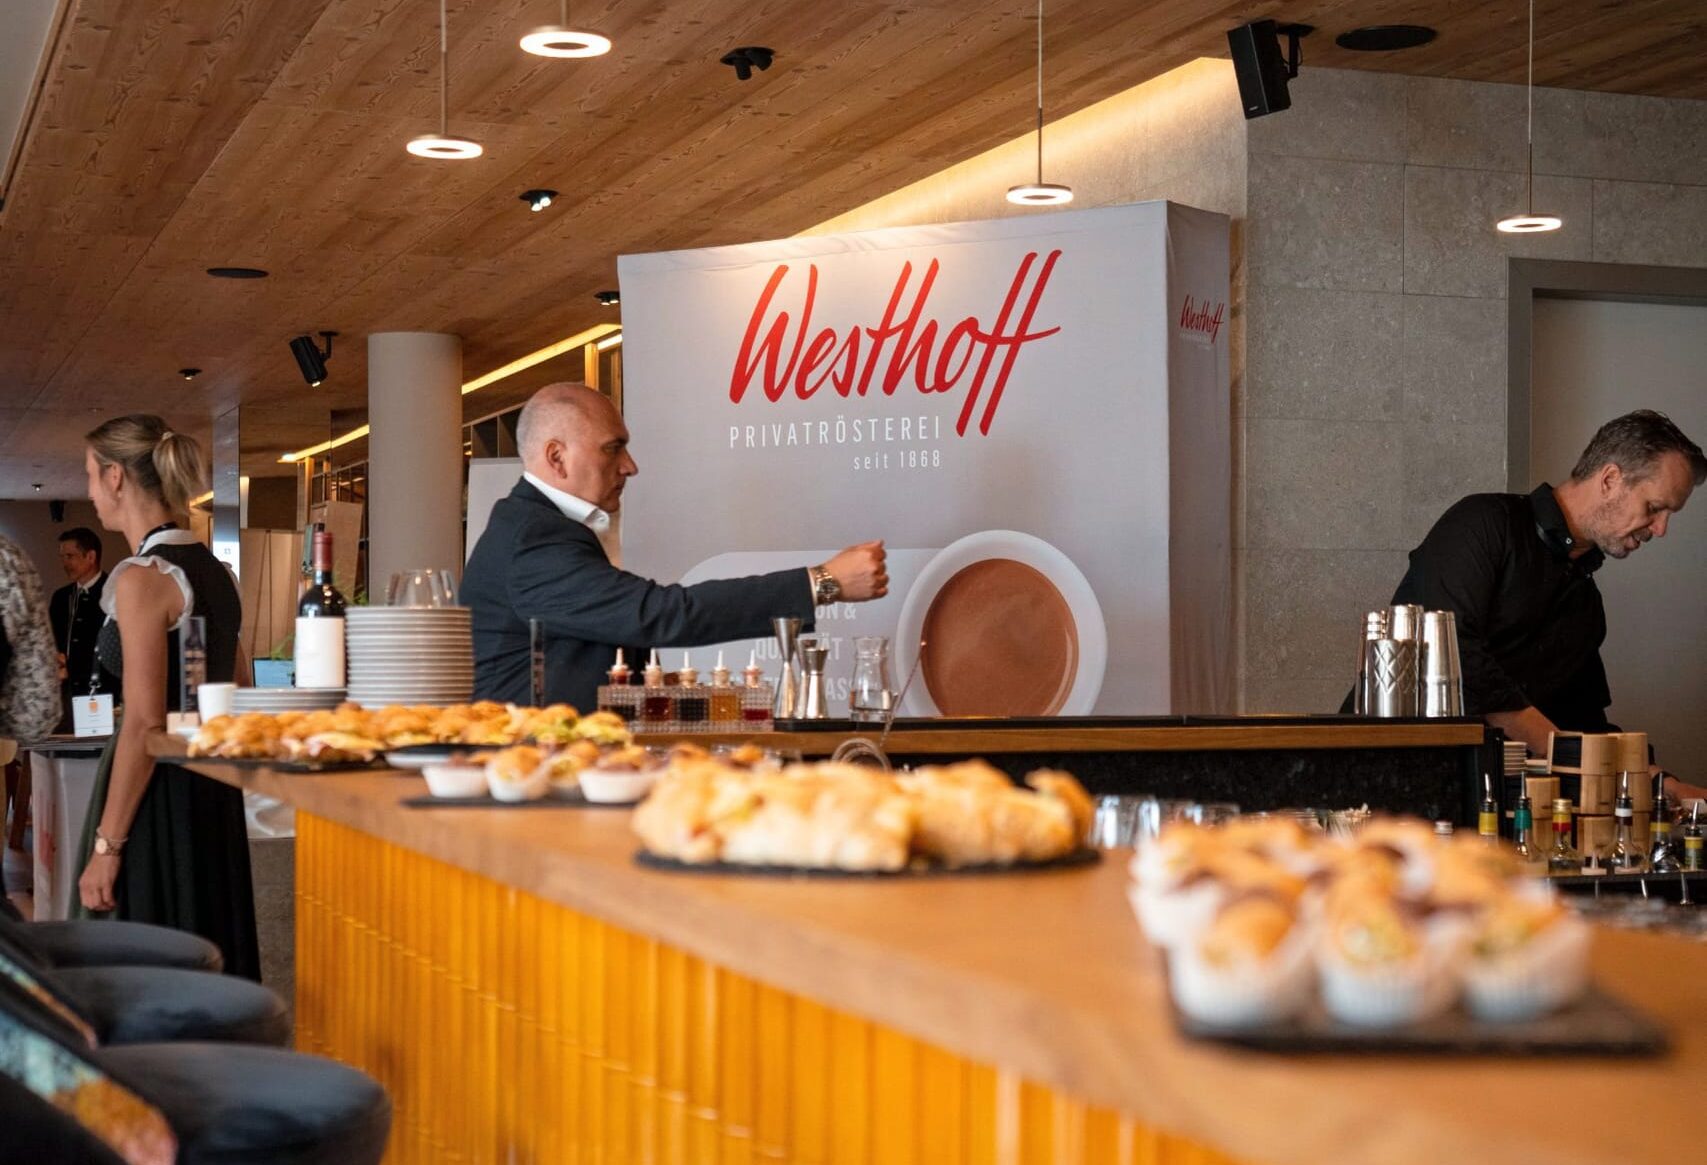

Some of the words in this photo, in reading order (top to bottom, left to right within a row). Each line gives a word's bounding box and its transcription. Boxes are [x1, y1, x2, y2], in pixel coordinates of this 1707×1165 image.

[1180, 294, 1224, 344] Westhoff
[729, 249, 1062, 437] Westhoff
[729, 415, 941, 449] PRIVATRÖSTEREI
[853, 451, 890, 470] seit
[900, 450, 941, 469] 1868
